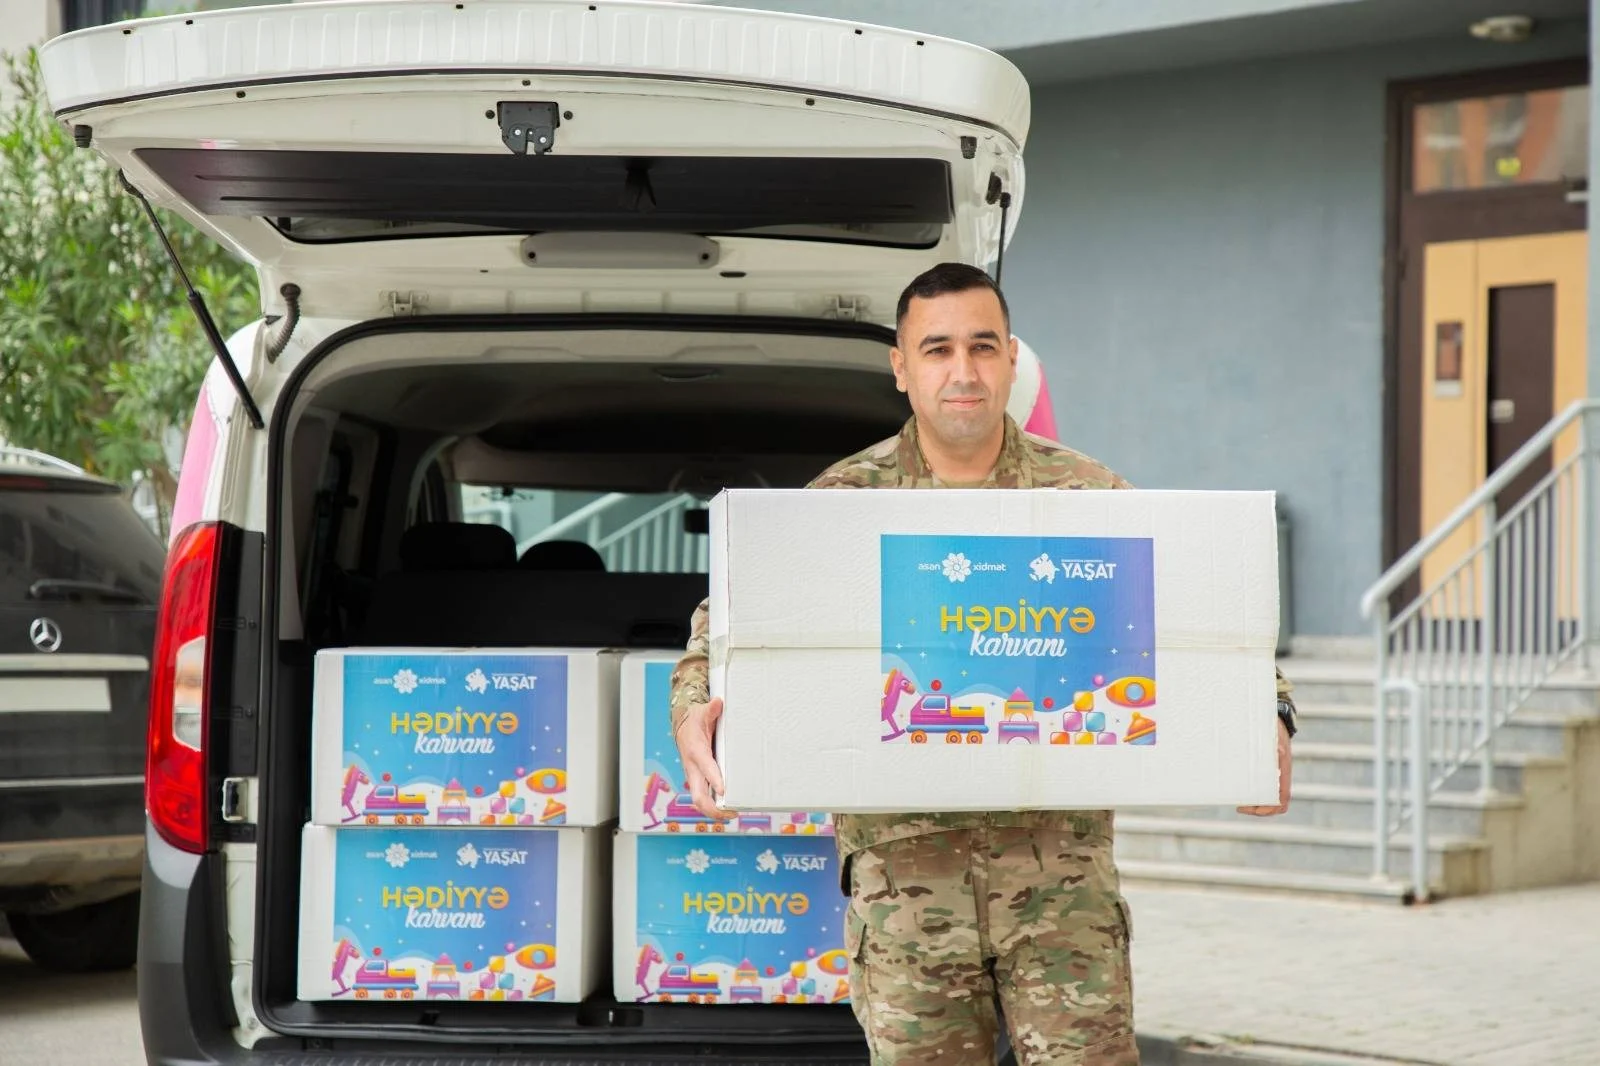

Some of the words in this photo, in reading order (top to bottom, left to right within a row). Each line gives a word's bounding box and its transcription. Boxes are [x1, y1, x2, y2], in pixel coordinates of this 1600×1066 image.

[917, 562, 941, 571] asan
[1061, 562, 1117, 581] YAŞAT
[939, 598, 1096, 634] HƏDİYYƏ
[969, 626, 1068, 657] karvanı
[491, 675, 538, 692] YAŞAT
[391, 706, 519, 735] HƏDİYYƏ
[413, 731, 496, 754] karvanı
[482, 850, 529, 866] YAŞAT
[782, 856, 828, 872] YAŞAT
[381, 880, 510, 910] HƏDİYYƏ
[683, 886, 810, 915] HƏDİYYƏ
[404, 904, 487, 929] karvanı
[706, 909, 787, 935] karvanı
